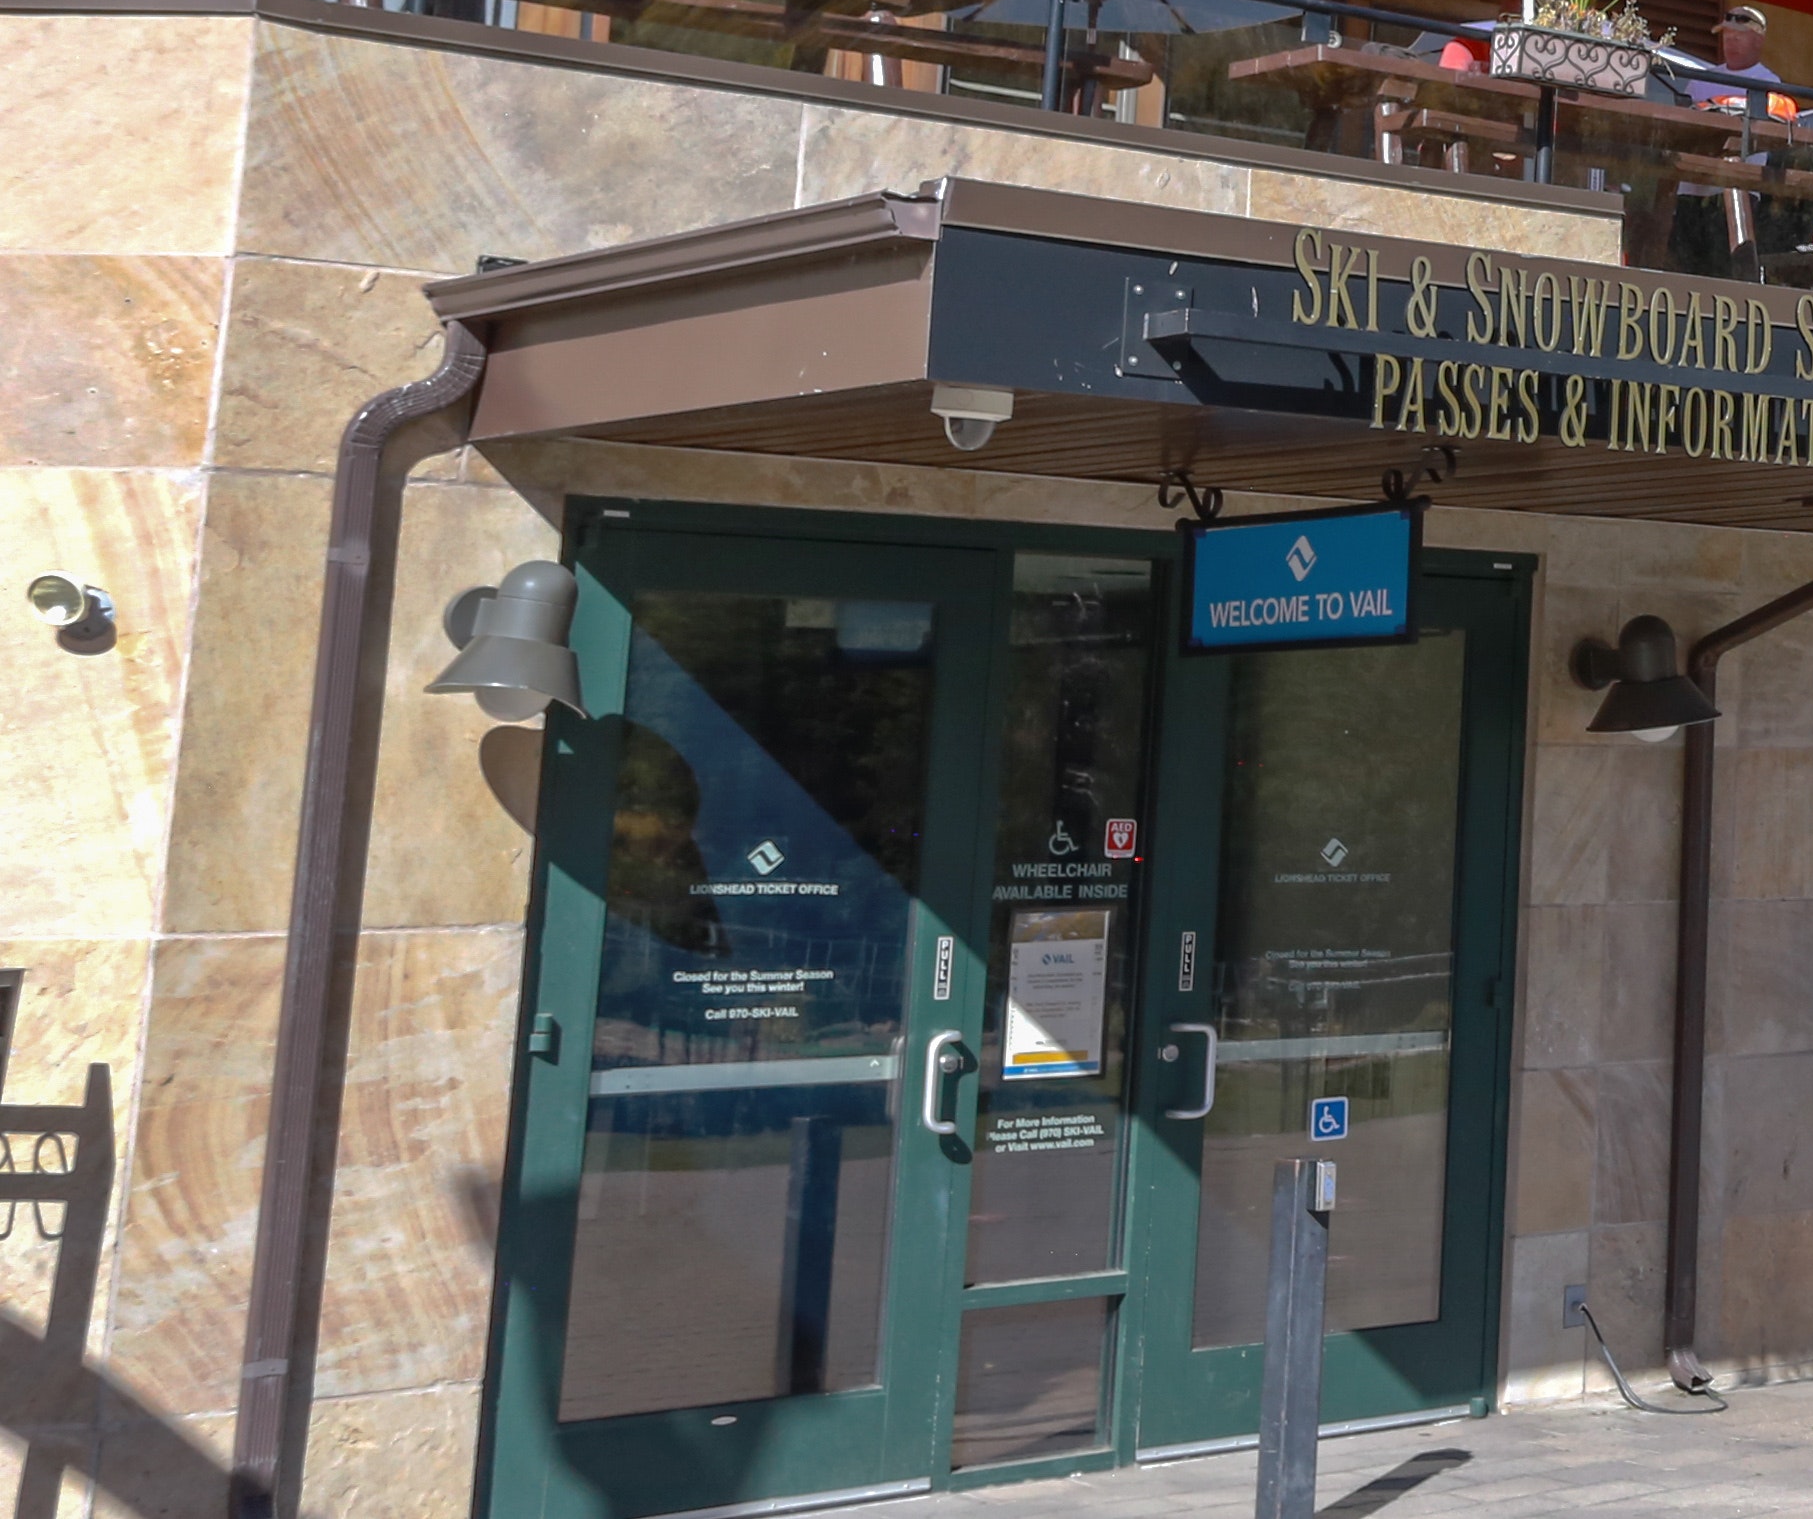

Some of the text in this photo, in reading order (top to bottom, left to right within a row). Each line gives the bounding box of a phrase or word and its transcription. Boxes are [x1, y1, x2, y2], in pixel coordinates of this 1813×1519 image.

[1293, 229, 1379, 331] SKI
[1407, 256, 1437, 337] &
[1467, 252, 1772, 374] SNOWBOARD
[1369, 353, 1538, 444] PASSES
[1560, 375, 1588, 448] &
[1210, 589, 1392, 628] WELCOME TO VAIL
[1111, 822, 1132, 832] AED
[1012, 863, 1112, 877] WHEELCHAIR
[690, 883, 839, 895] LIONSHEAD TICKET OFFICE
[992, 884, 1128, 899] AVAILABLE INSIDE
[1052, 954, 1075, 964] VAIL
[1184, 934, 1193, 972] PULL
[939, 941, 949, 980] PULL
[673, 969, 835, 983] Closed for the Summer Season
[702, 981, 804, 995] See you this winter!
[705, 1007, 799, 1020] Call 970-SKI-VAIL
[997, 1115, 1095, 1129] For More Information
[1020, 1128, 1038, 1140] Call
[1064, 1125, 1104, 1137] SKI-VAIL
[995, 1144, 1006, 1153] or
[1030, 1139, 1094, 1151] www.vail.com
